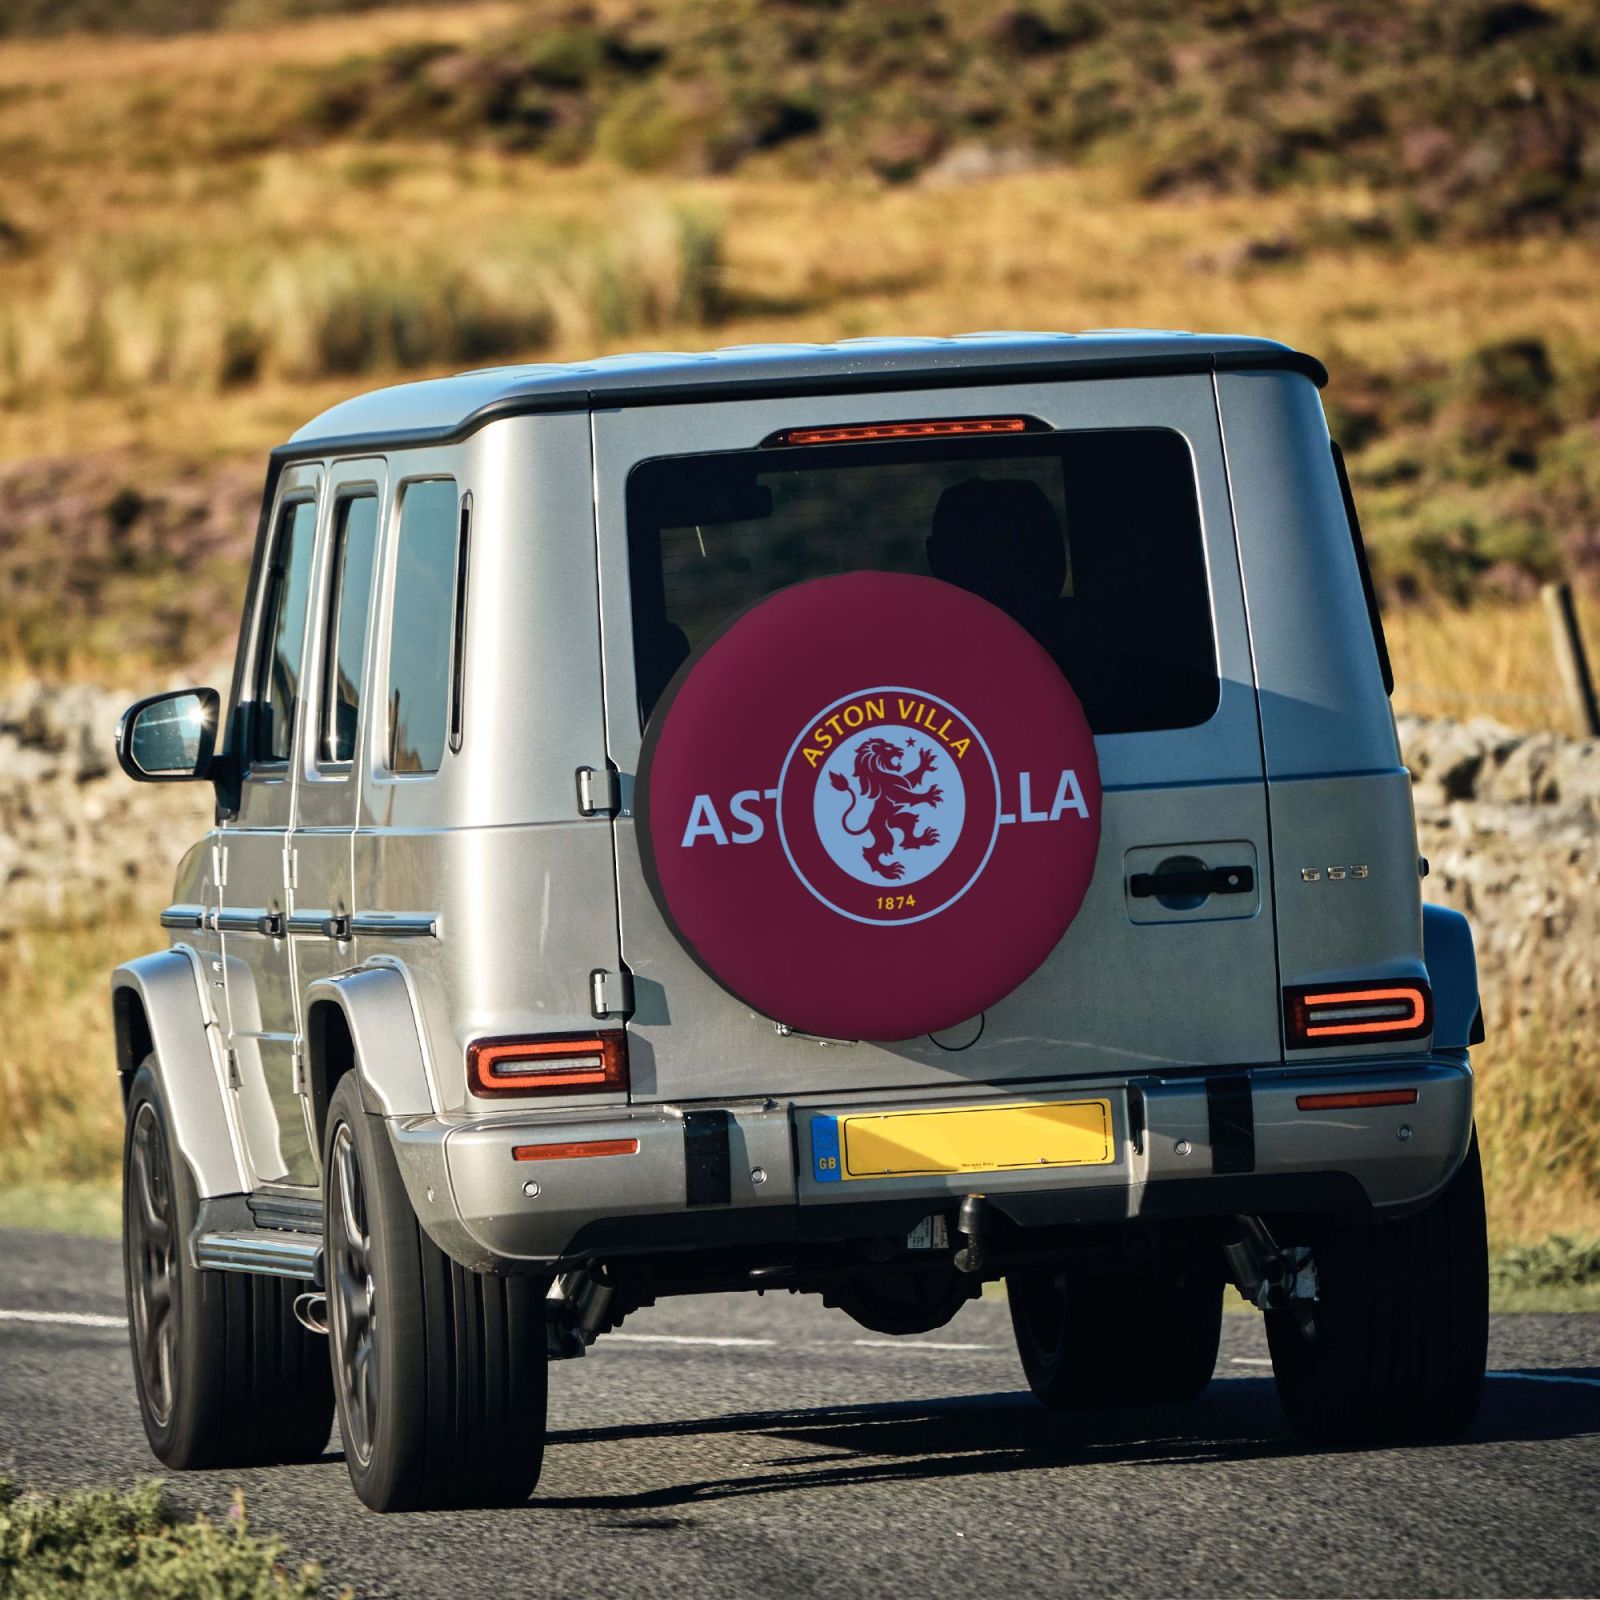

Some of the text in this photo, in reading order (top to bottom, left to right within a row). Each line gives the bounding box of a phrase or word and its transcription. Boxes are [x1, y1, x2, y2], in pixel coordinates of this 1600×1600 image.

[803, 699, 971, 768] ASTON VILLA
[1000, 769, 1090, 824] LA
[877, 894, 916, 910] 1874
[819, 1156, 836, 1169] GB
